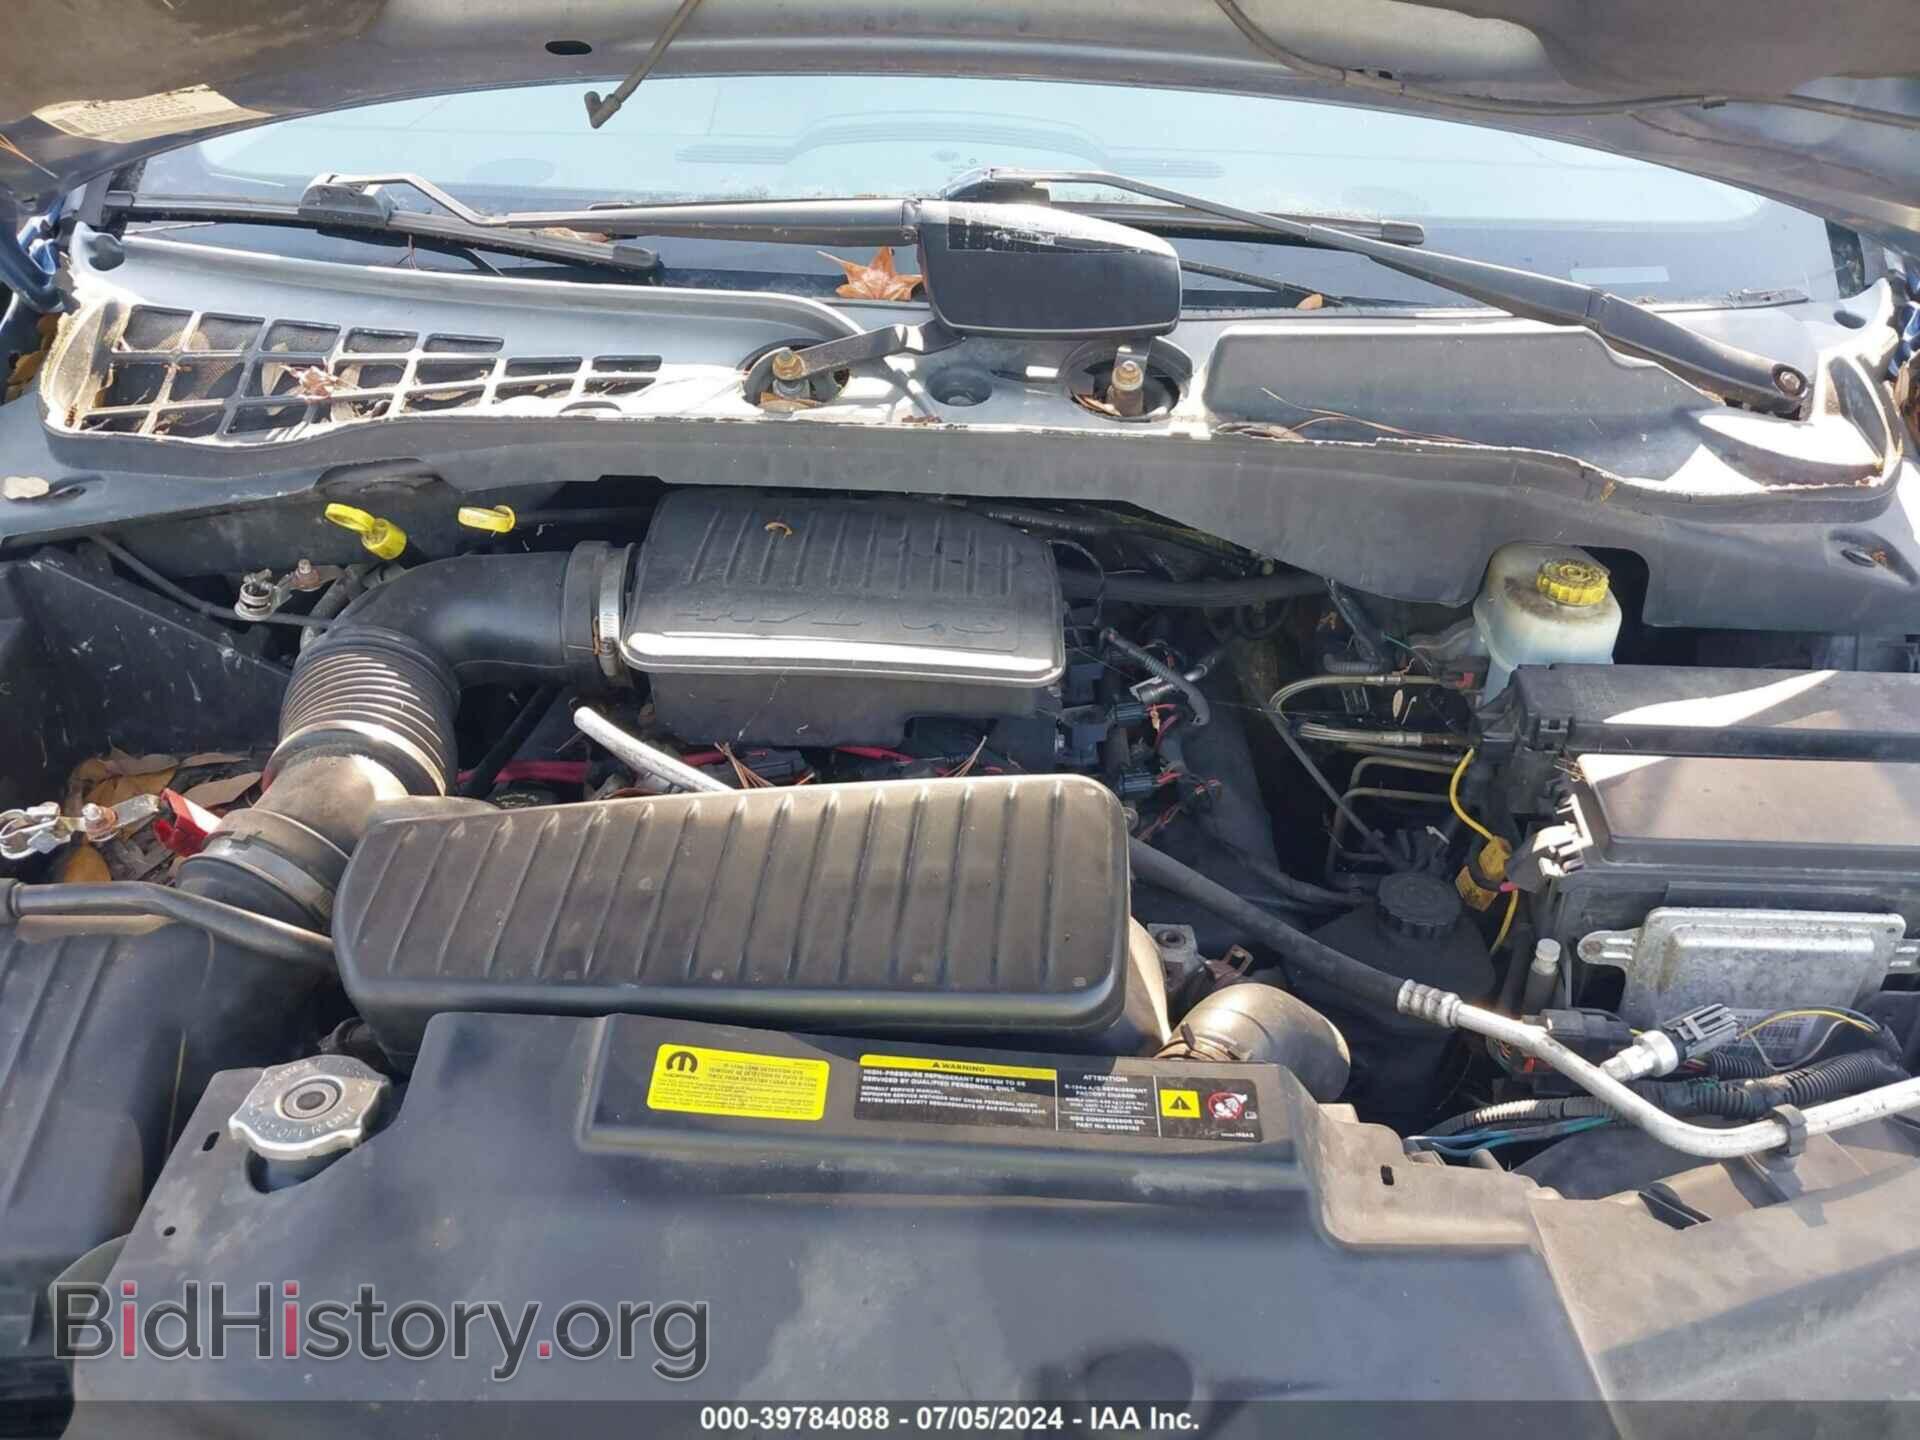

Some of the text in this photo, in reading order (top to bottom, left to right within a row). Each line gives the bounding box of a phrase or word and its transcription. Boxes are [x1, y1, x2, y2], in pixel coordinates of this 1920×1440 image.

[942, 1063, 985, 1072] WARNING
[863, 1069, 923, 1078] HIGH-PRESSURE
[975, 1076, 1004, 1085] SYSTEM
[911, 1079, 950, 1087] QUALIFIED
[951, 1082, 993, 1090] PERSONNEL
